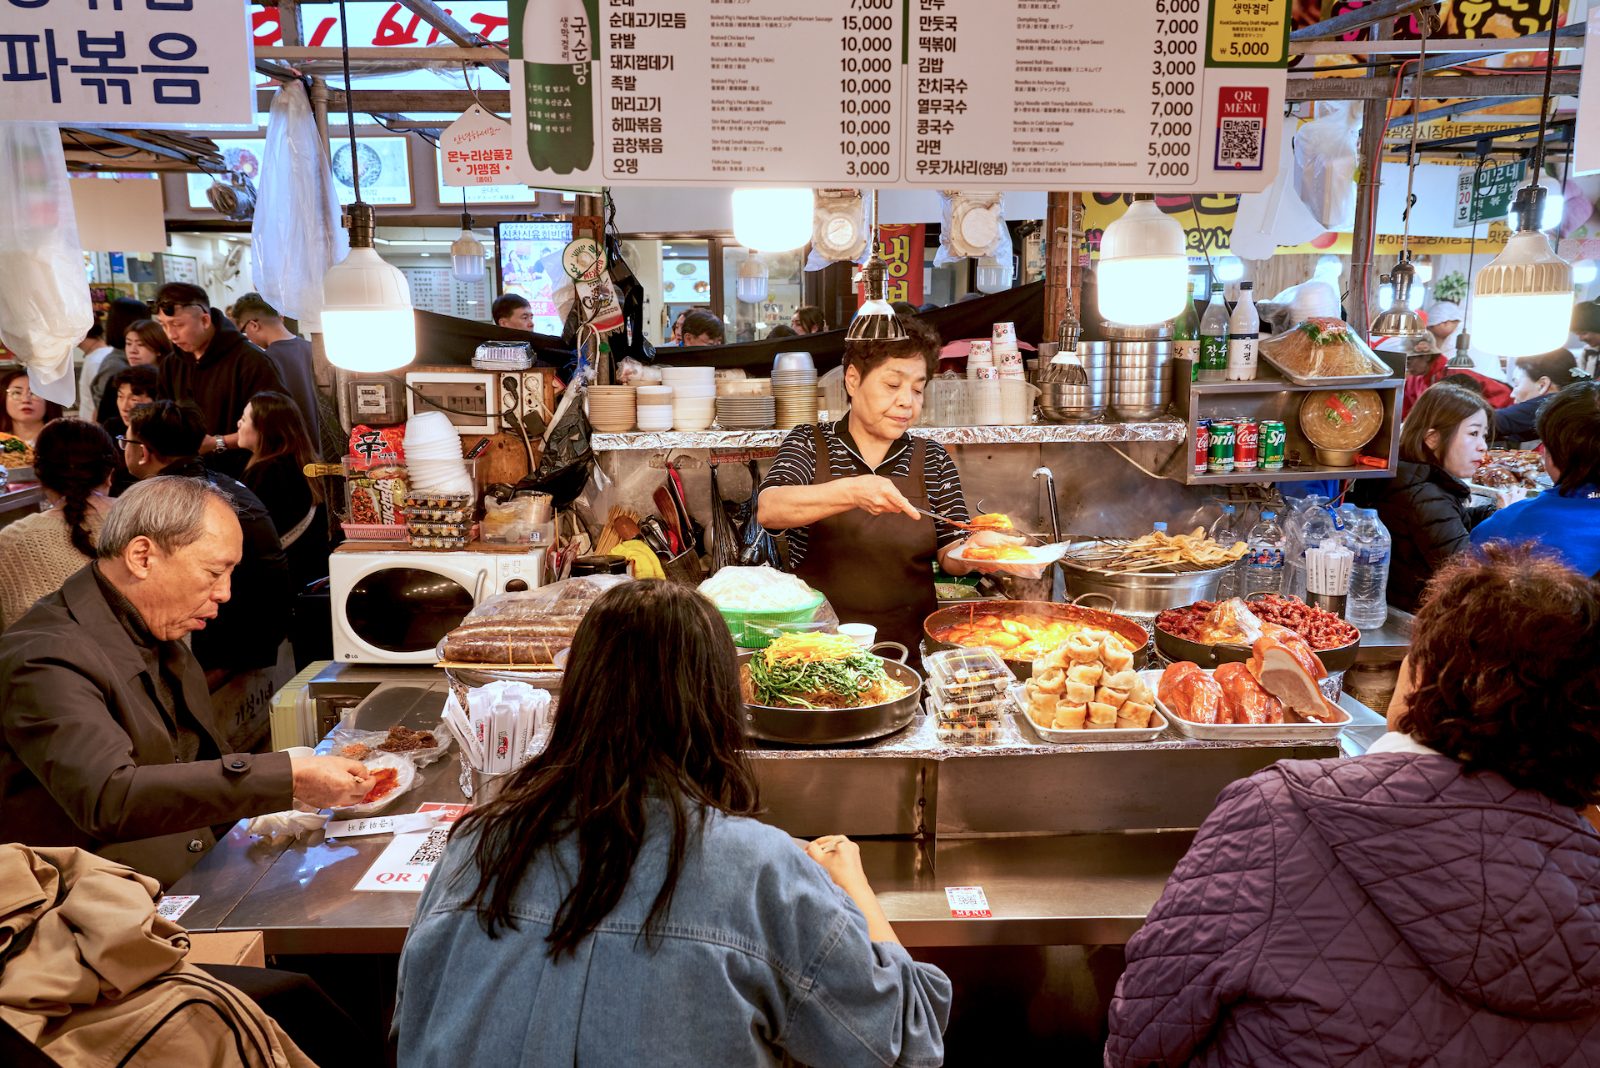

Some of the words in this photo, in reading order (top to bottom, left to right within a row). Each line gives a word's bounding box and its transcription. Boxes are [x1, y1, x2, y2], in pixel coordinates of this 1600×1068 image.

[1233, 3, 1268, 15] 생막걸리
[609, 12, 686, 29] 순대고기모듬
[842, 16, 892, 32] 15,000
[1156, 19, 1198, 35] 7,000
[560, 17, 569, 61] 생막걸리
[610, 33, 636, 49] 닭발
[841, 37, 892, 53] 10,000
[919, 37, 956, 53] 떡볶이
[570, 17, 589, 85] 국순당
[1154, 40, 1197, 56] 3,000
[1230, 42, 1269, 57] 5,000
[0, 29, 209, 105] 파볶음
[610, 55, 673, 71] 돼지껍데기
[841, 58, 891, 74] 10,000
[919, 58, 944, 73] 김밥
[1153, 61, 1196, 77] 3,000
[611, 76, 637, 91] 족발
[841, 79, 891, 95] 10,000
[918, 78, 968, 94] 잔치국수
[1152, 81, 1194, 97] 5,000
[612, 96, 661, 112] 머리고기
[1234, 91, 1253, 102] QR
[841, 99, 891, 116] 10,000
[918, 99, 967, 114] 열무국수
[1152, 102, 1193, 118] 7,000
[1224, 103, 1260, 113] MENU
[612, 117, 662, 133] 허파볶음
[840, 120, 890, 136] 10,000
[917, 119, 954, 135] 콩국수
[1150, 122, 1192, 138] 7,000
[612, 138, 663, 153] 곱창볶음
[840, 141, 890, 157] 10,000
[917, 140, 941, 155] 라면
[1148, 142, 1190, 158] 5,000
[466, 164, 501, 176] 가맹점
[613, 158, 638, 174] 오뎅
[847, 161, 889, 177] 3,000
[1148, 162, 1189, 177] 7,000
[1459, 192, 1470, 204] 20
[1206, 344, 1228, 357] 장수
[355, 432, 387, 466] 辛
[376, 872, 412, 884] QR
